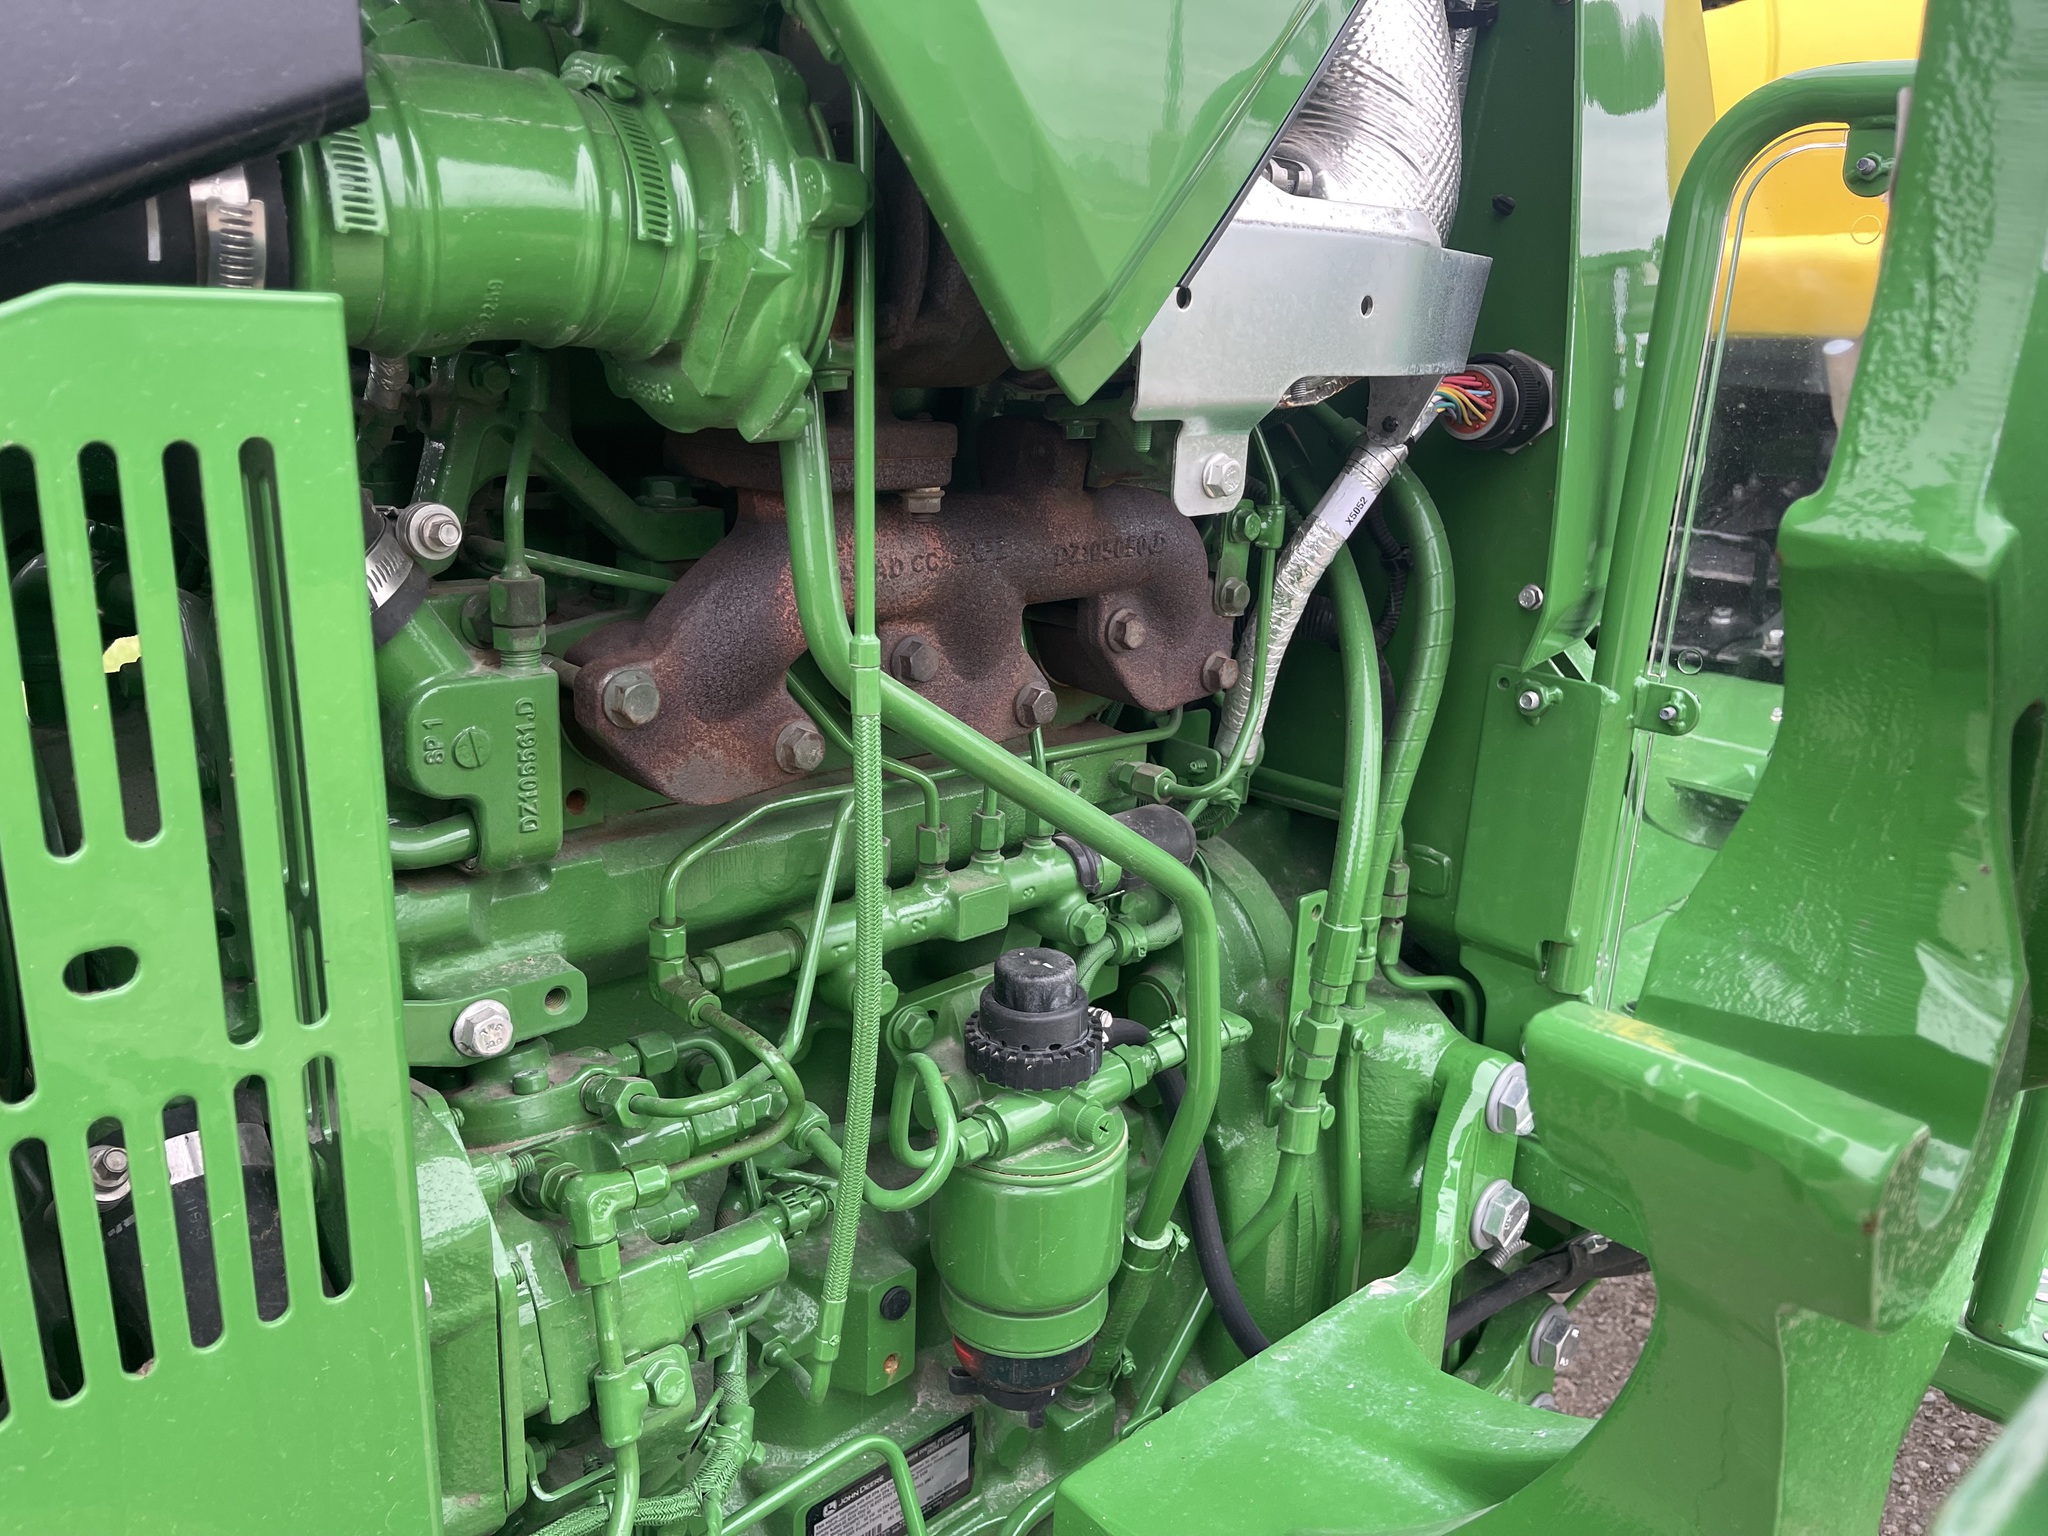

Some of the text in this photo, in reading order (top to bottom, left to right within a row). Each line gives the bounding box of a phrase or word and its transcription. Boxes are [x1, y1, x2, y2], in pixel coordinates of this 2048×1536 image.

[1345, 496, 1368, 526] X5052
[839, 1490, 860, 1507] JOHN
[860, 1475, 885, 1494] DEERE
